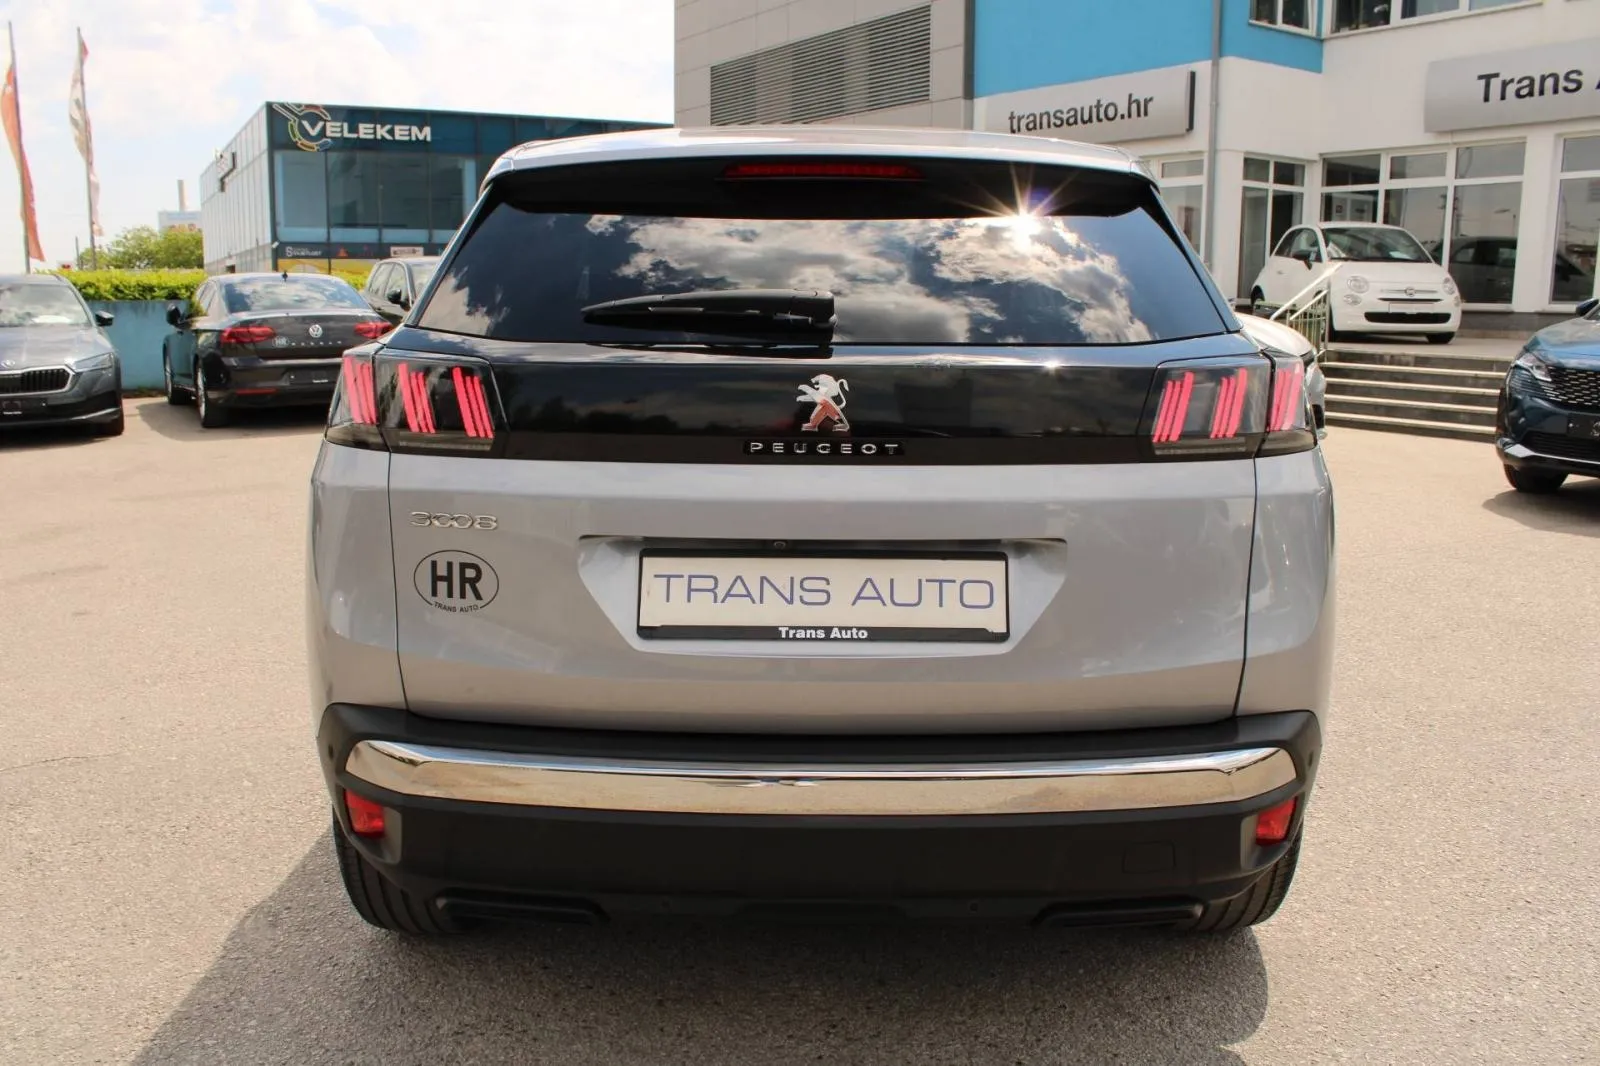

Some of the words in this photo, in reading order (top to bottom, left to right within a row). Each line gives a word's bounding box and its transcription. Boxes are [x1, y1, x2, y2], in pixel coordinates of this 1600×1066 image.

[1477, 69, 1584, 103] Trans
[1008, 93, 1154, 134] transauto.hr
[302, 120, 432, 142] VELEKEM
[750, 442, 898, 455] PEUGEOT
[410, 511, 498, 530] 3008
[431, 560, 483, 601] HR
[652, 574, 831, 606] TRANS
[851, 577, 994, 609] AUTO
[434, 601, 457, 613] TRANS
[460, 603, 479, 613] AUTO
[778, 627, 826, 639] Trans
[830, 627, 868, 639] Auto
